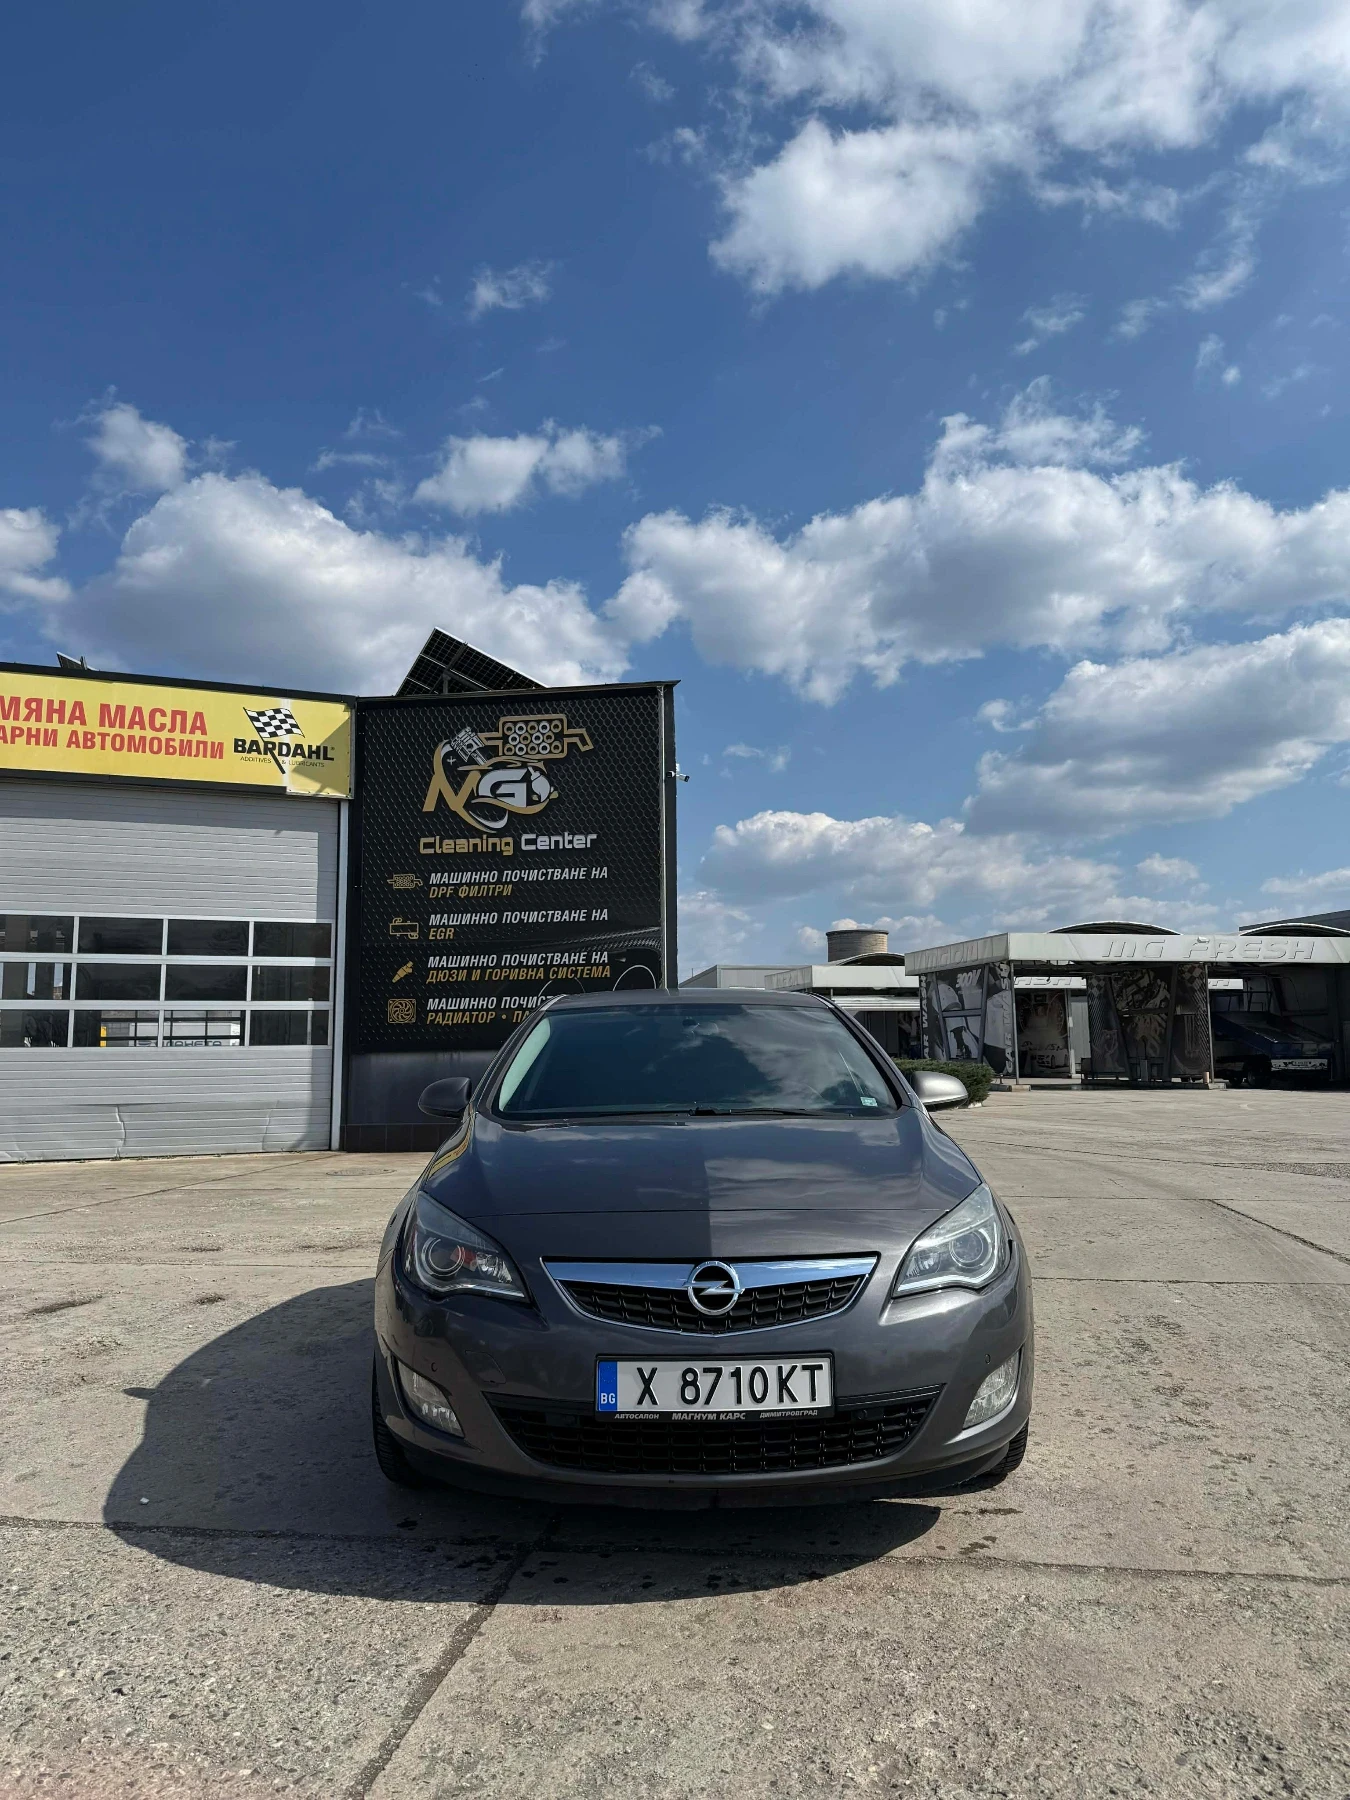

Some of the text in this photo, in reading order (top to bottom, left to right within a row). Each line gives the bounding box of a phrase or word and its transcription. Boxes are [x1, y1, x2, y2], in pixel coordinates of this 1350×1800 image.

[0, 694, 207, 735] МЯНА МАСЛА
[66, 730, 225, 759] АВТОМОБИЛИ
[420, 831, 598, 855] Cleaning Center
[429, 866, 608, 885] МАШИННО ПОЧИСТВАНЕ НА
[429, 884, 512, 898] DPF ФИЛТРИ
[429, 909, 608, 926] МАШИННО ПОЧИСТВАНЕ НА
[429, 928, 454, 940] EGR
[1183, 937, 1315, 959] FRESH
[428, 951, 608, 968] МАШИННО ПОЧИСТВАНЕ НА
[426, 966, 611, 984] ДЮЗИ И ГОРИВНА СИСТЕМА
[427, 997, 497, 1010] МАШИННО
[427, 1011, 496, 1026] РАДИАТОР
[1000, 963, 1014, 1074] CAR WASH
[600, 1393, 615, 1404] BG
[636, 1367, 659, 1405] X
[672, 1412, 717, 1420] МАГНУМ
[719, 1412, 746, 1420] КАРС
[759, 1409, 818, 1419] ДИМИТРОВГРАД
